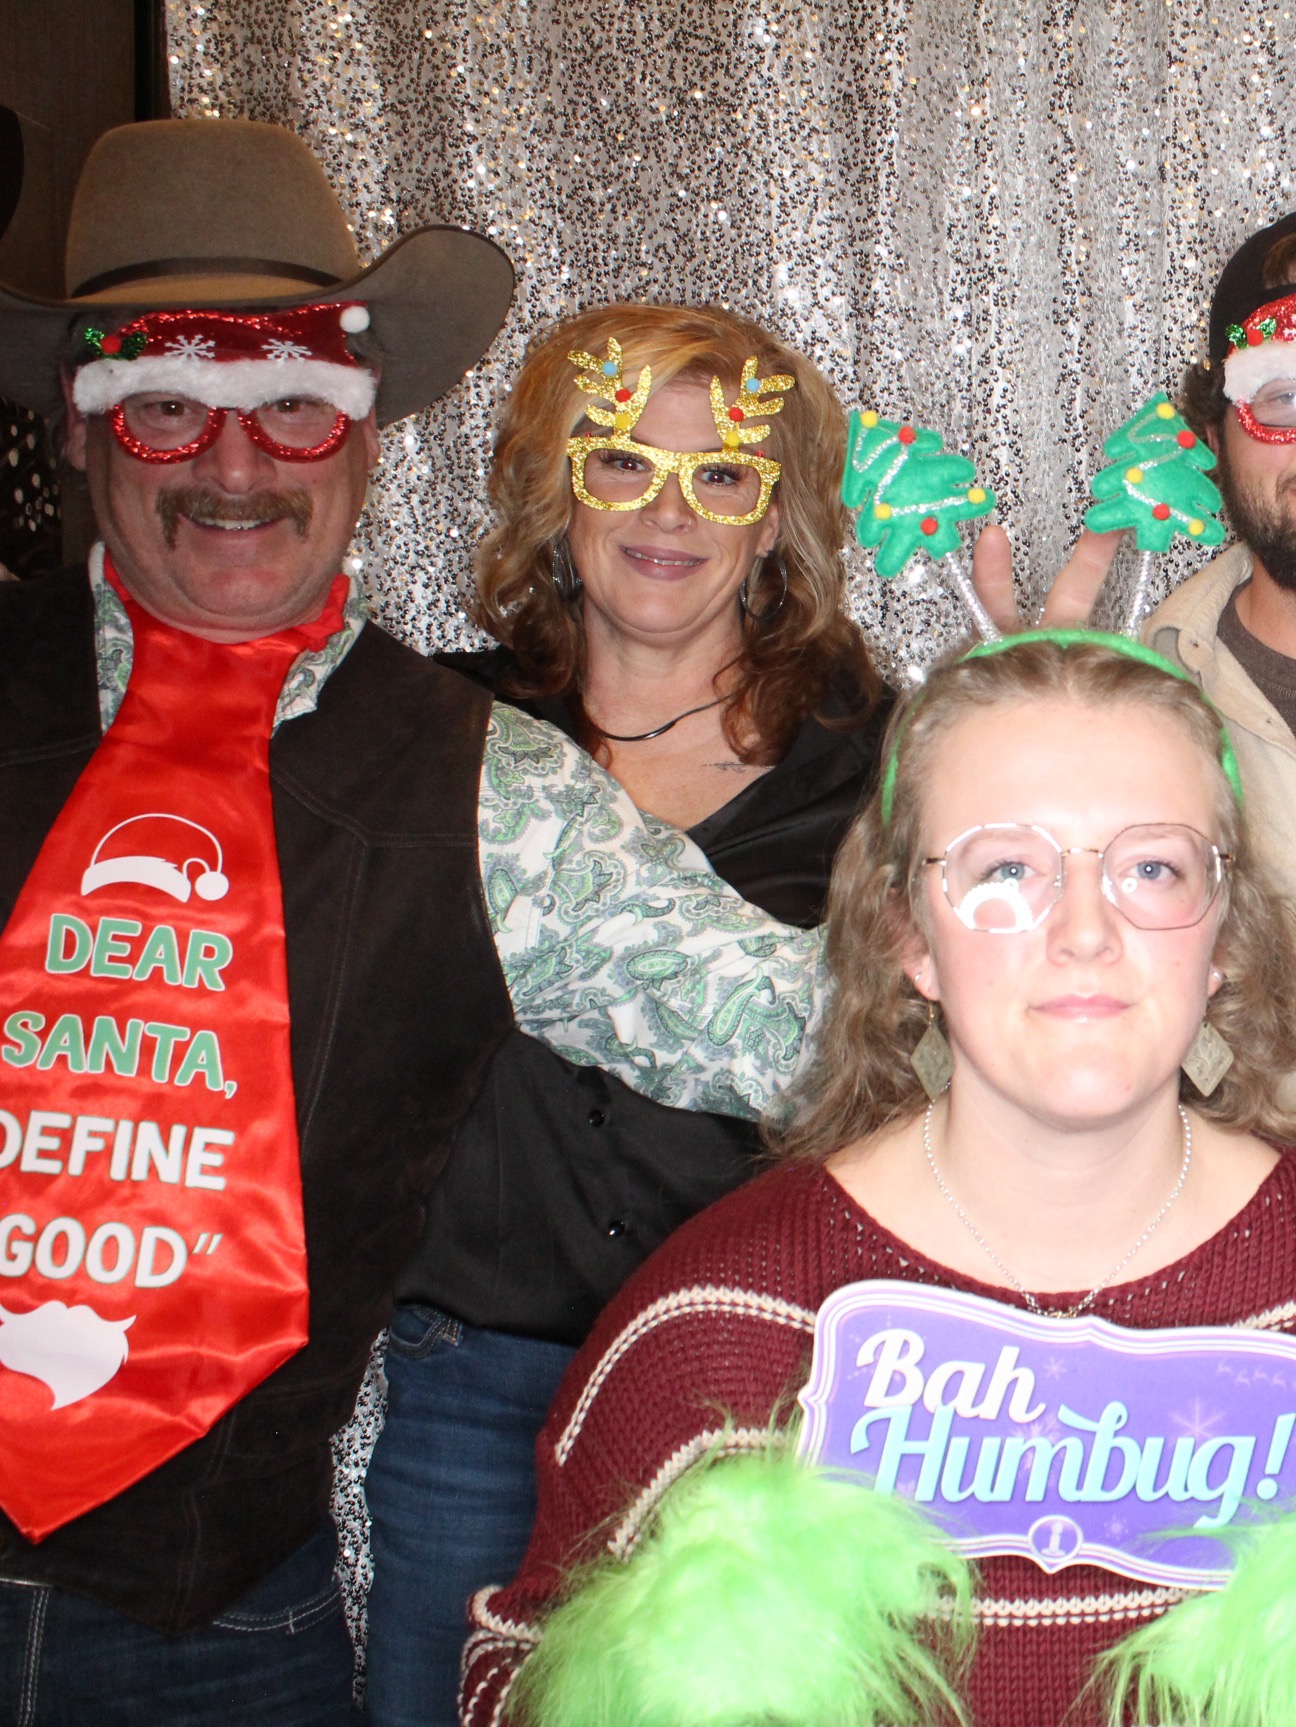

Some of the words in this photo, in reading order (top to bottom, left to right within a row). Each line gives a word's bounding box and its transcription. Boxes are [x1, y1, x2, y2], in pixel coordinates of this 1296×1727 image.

[45, 913, 233, 991] DEAR
[1, 1010, 237, 1098] SANTA,
[856, 1328, 1046, 1423] Bah
[850, 1401, 1296, 1529] Humbug!
